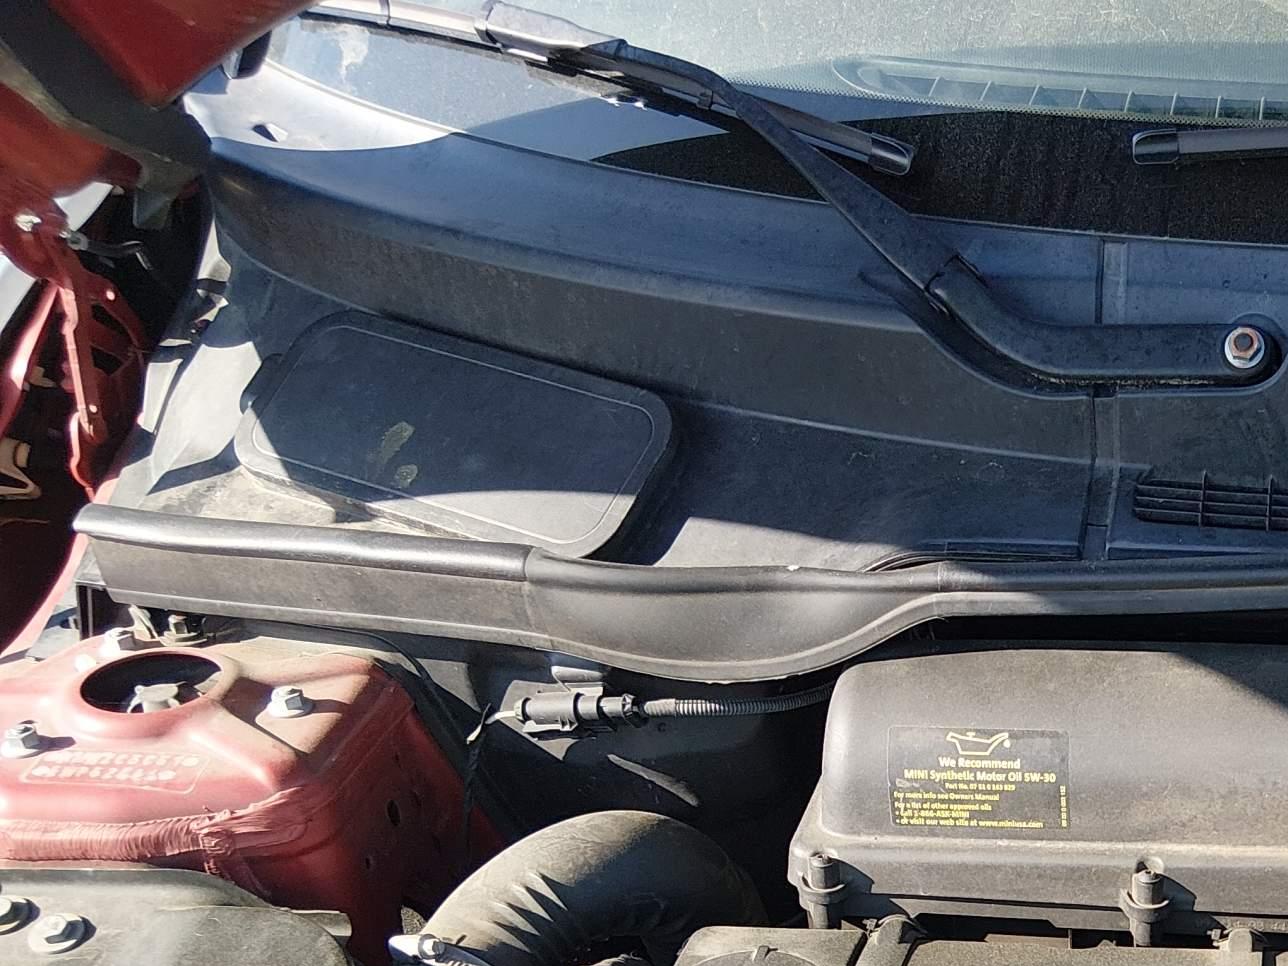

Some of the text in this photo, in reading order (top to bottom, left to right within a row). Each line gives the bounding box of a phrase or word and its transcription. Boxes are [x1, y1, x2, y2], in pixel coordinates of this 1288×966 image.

[938, 757, 1020, 769] We Recommend
[904, 769, 1056, 783] MINI Synthetic Motor Oil 5W-30
[894, 791, 904, 799] For
